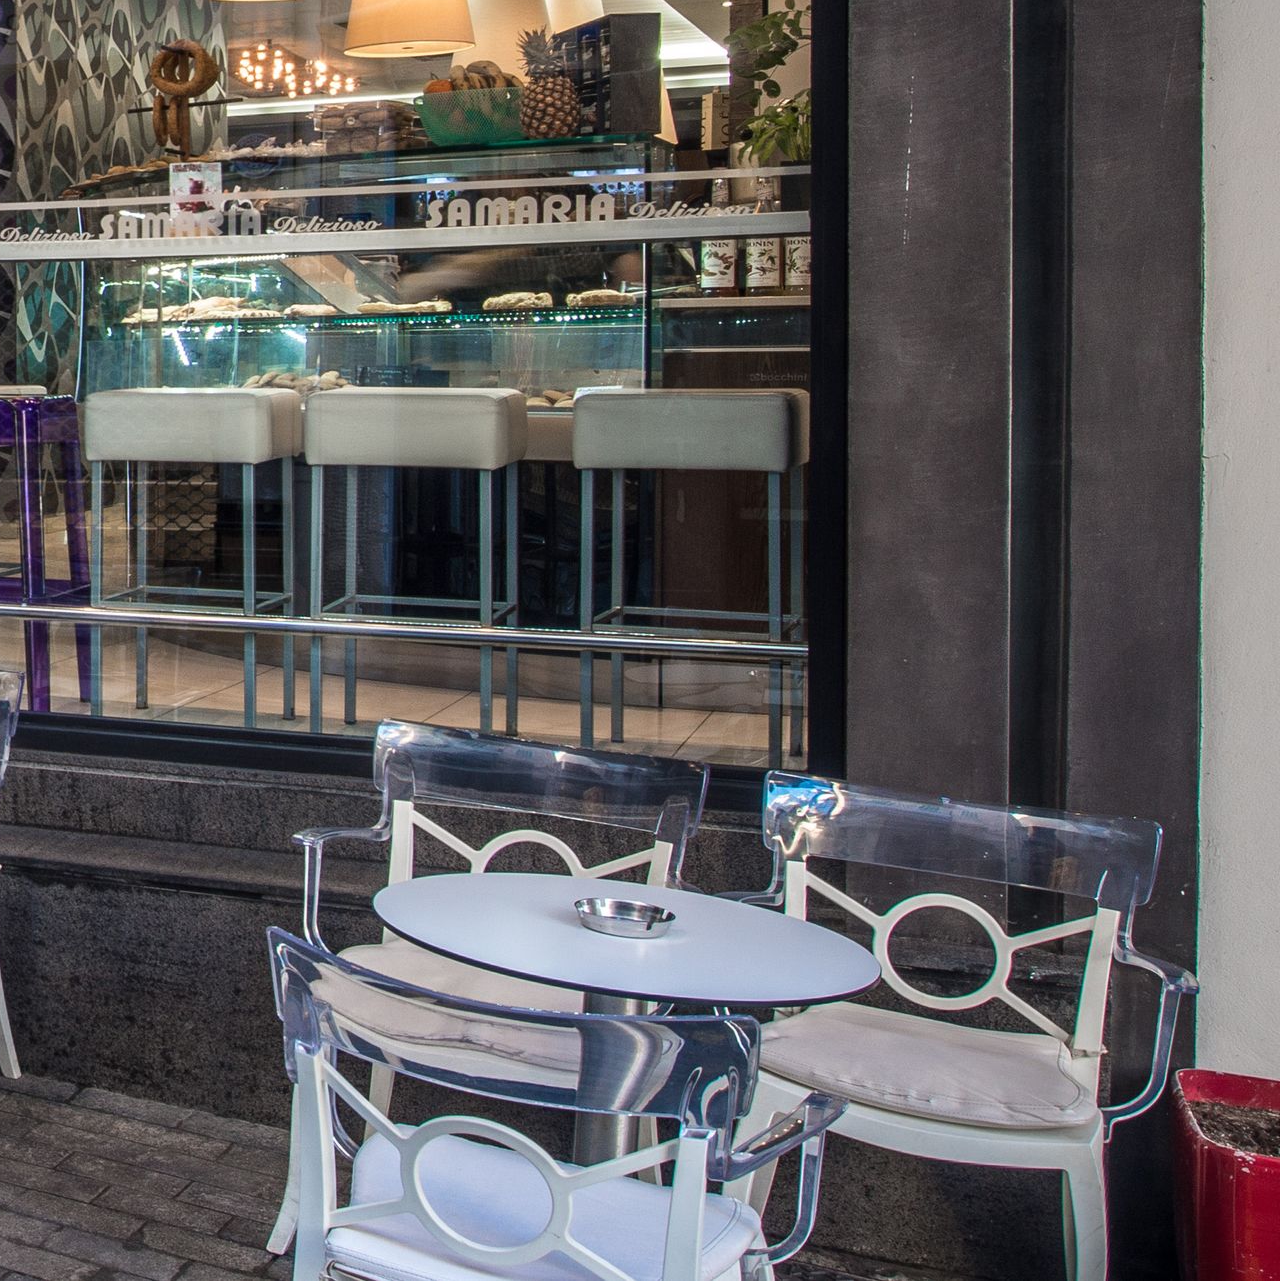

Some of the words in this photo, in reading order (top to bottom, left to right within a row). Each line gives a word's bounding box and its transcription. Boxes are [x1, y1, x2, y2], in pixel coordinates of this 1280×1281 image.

[99, 207, 262, 239] SAMARIA
[273, 215, 382, 235] Delizioso
[425, 193, 616, 228] SAMARIA
